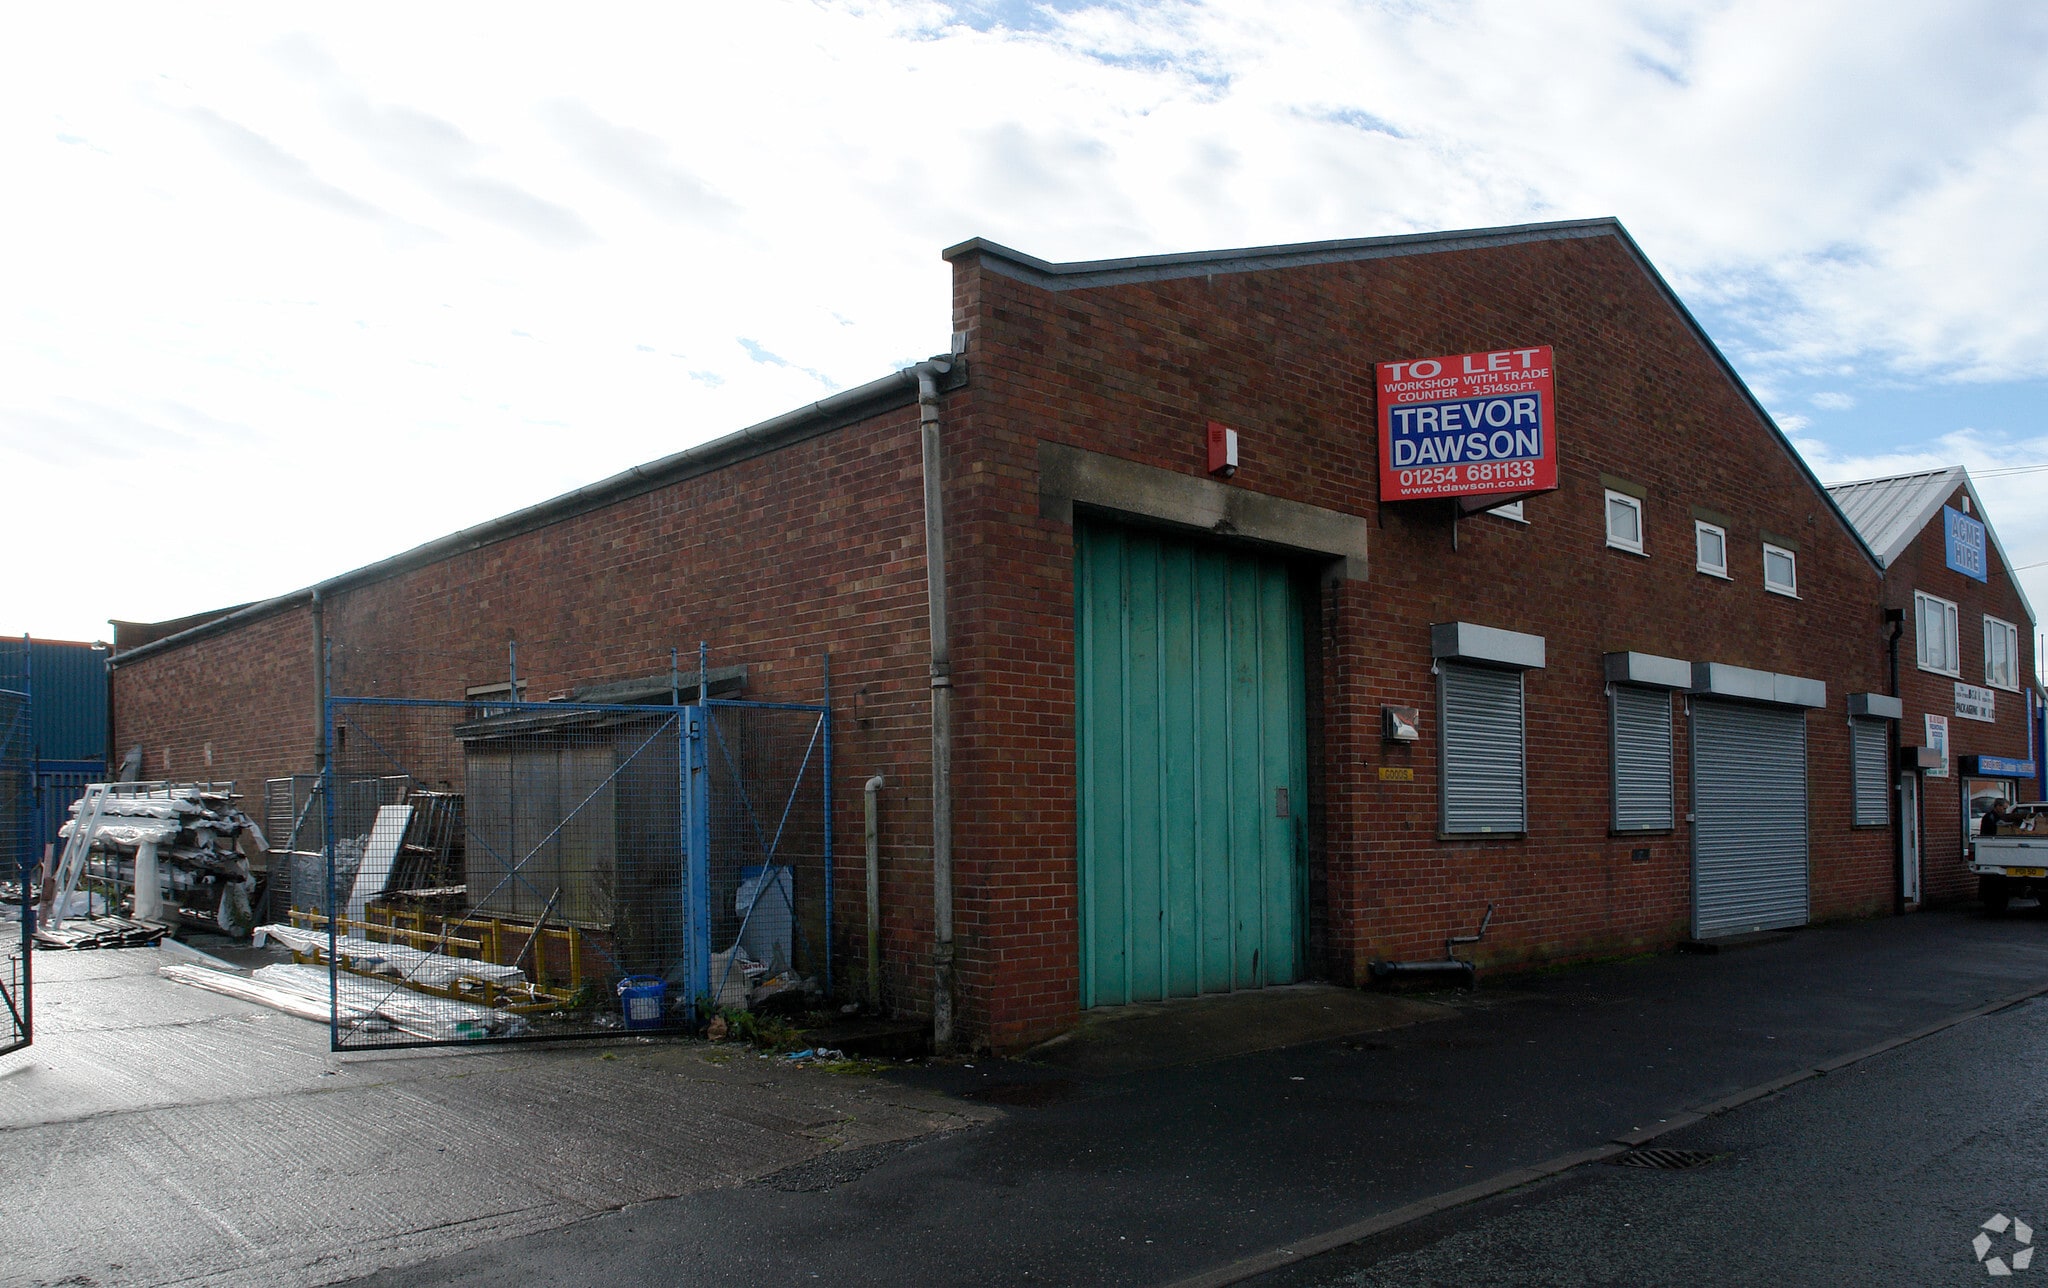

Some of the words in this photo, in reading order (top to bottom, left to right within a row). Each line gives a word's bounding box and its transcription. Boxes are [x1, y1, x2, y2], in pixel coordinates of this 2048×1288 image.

[1384, 360, 1442, 381] TO
[1463, 349, 1540, 374] LET
[1384, 377, 1459, 393] WORKSHOP
[1463, 373, 1498, 385] WITH
[1503, 368, 1549, 381] TRADE
[1397, 388, 1458, 402] COUNTER
[1394, 398, 1537, 434] TREVOR
[1395, 428, 1538, 466] DAWSON
[1400, 467, 1458, 486] 01254
[1466, 461, 1535, 481] 681133
[1401, 478, 1535, 495] www.tdawson.co.uk
[1952, 514, 1980, 550] ACME
[1954, 540, 1979, 574] HIRE
